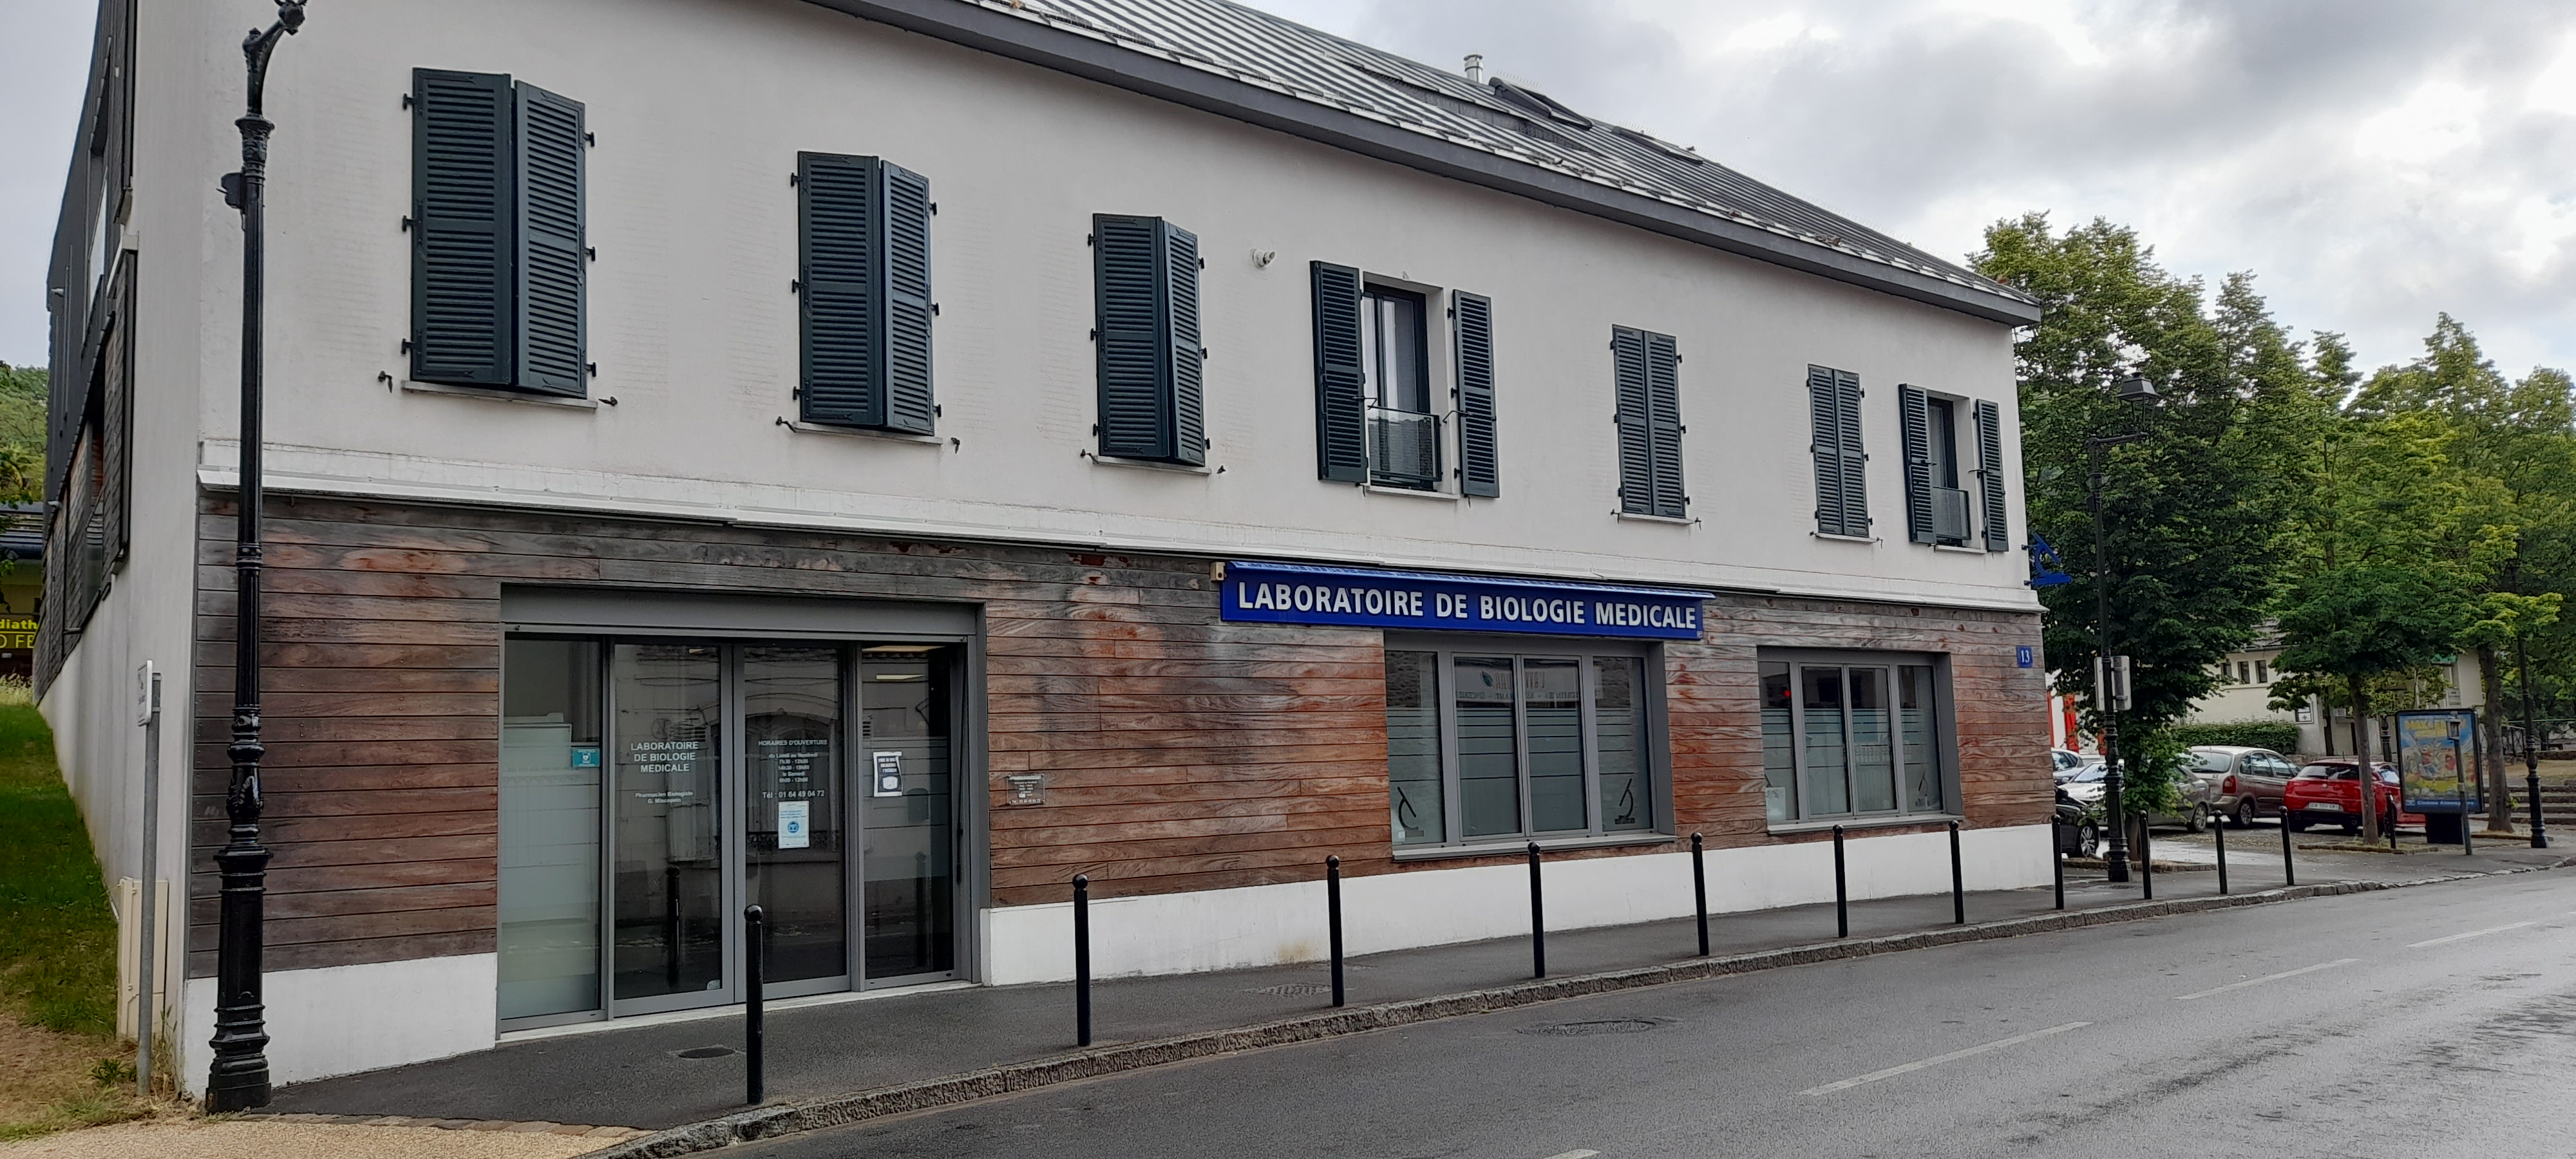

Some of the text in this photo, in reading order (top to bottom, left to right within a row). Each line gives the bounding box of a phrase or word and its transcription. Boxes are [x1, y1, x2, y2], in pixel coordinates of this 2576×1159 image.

[1239, 581, 1696, 629] LABORATOIRE DE BIOLOGIE MEDICALE
[2020, 649, 2030, 663] 13
[630, 741, 699, 751] LABORATOIRE
[634, 752, 696, 762] DE BIOLOGIE
[640, 763, 690, 773] MEDICALE
